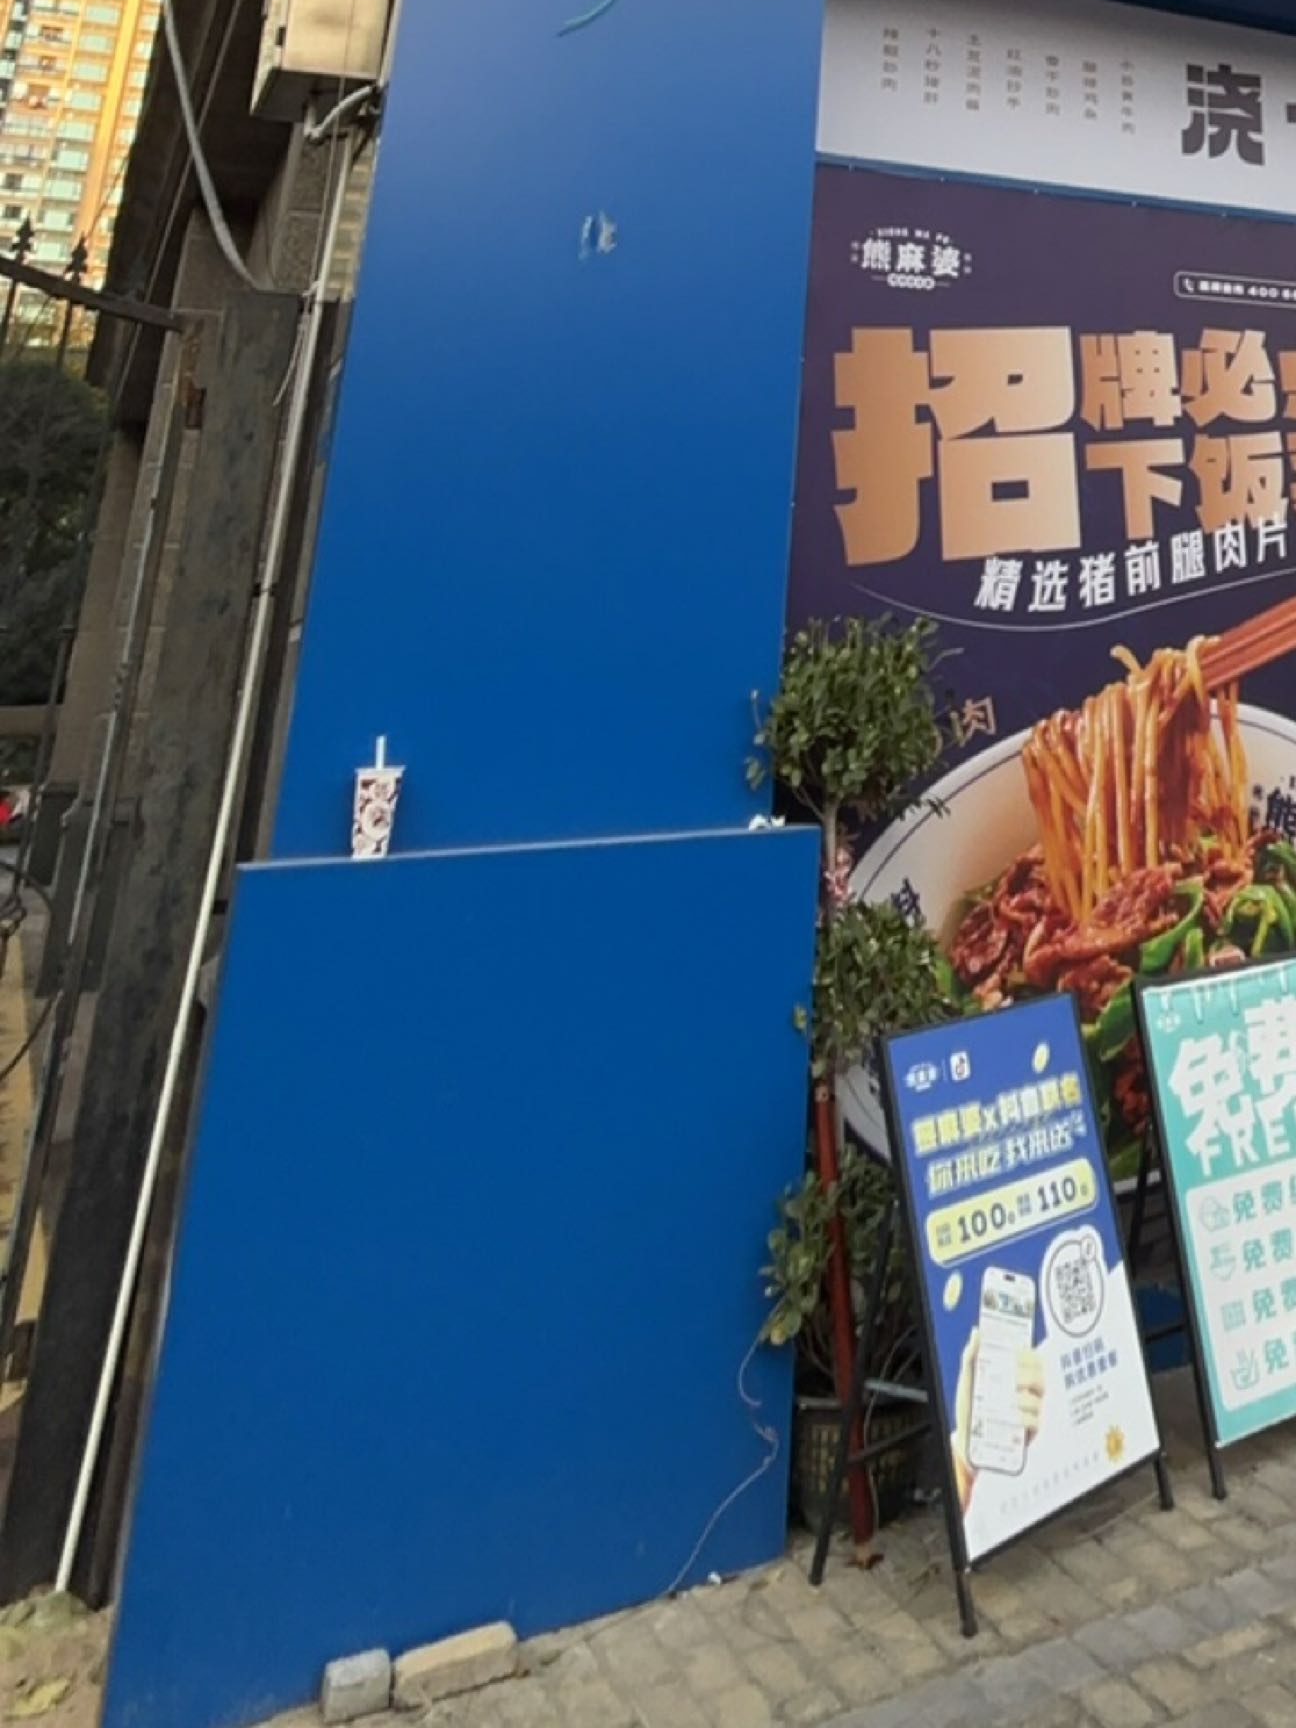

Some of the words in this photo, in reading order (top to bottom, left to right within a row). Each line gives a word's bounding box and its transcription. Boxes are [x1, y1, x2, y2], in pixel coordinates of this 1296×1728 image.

[862, 237, 961, 279] 熊麻婆
[831, 325, 1082, 567] 招
[973, 511, 1288, 613] 精选猪前腿肉片
